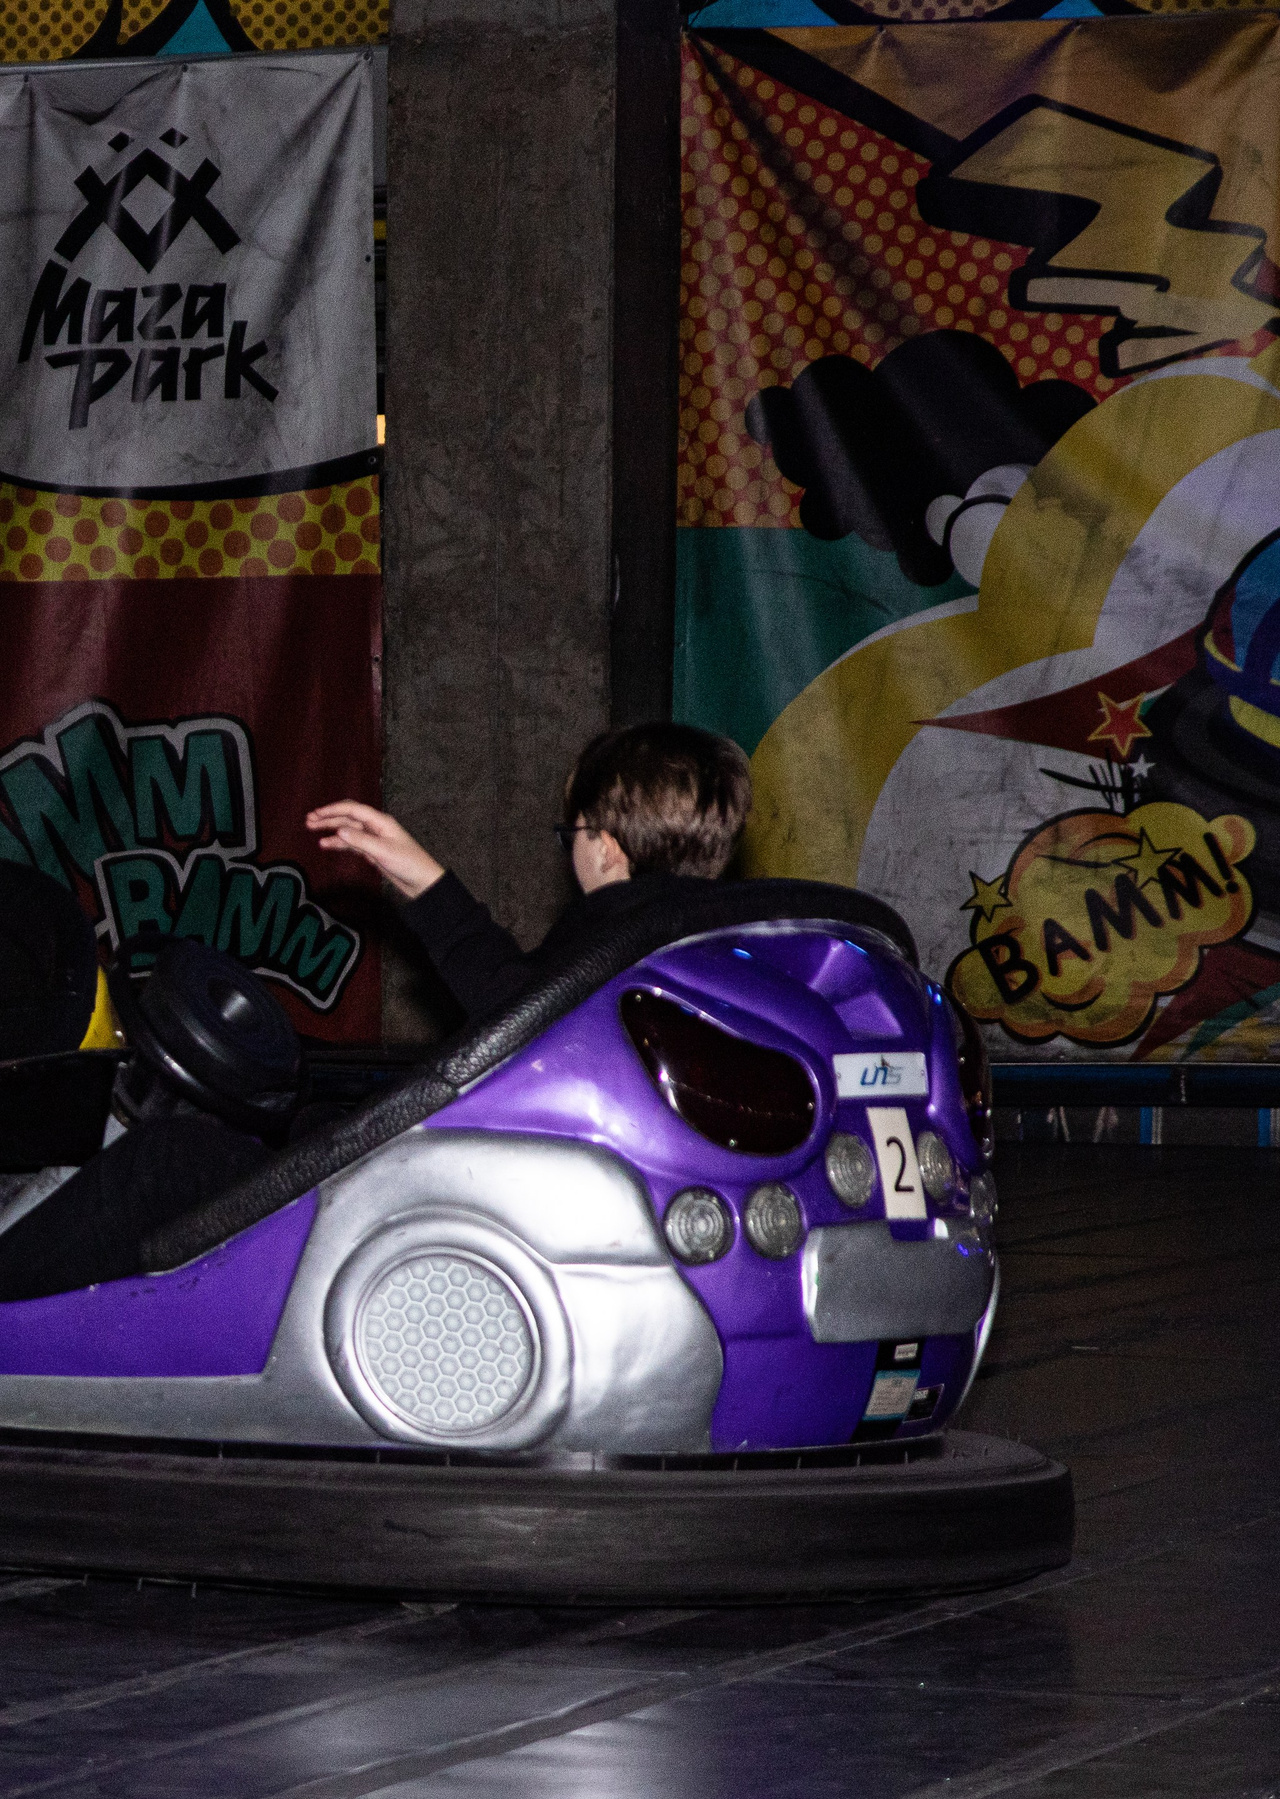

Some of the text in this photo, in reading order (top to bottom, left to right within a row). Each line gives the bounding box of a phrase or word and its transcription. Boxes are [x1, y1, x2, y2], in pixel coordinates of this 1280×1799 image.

[18, 259, 227, 363] Maza
[104, 852, 358, 994] BAMM
[978, 832, 1240, 1004] BAMM!
[886, 1136, 915, 1192] 2
